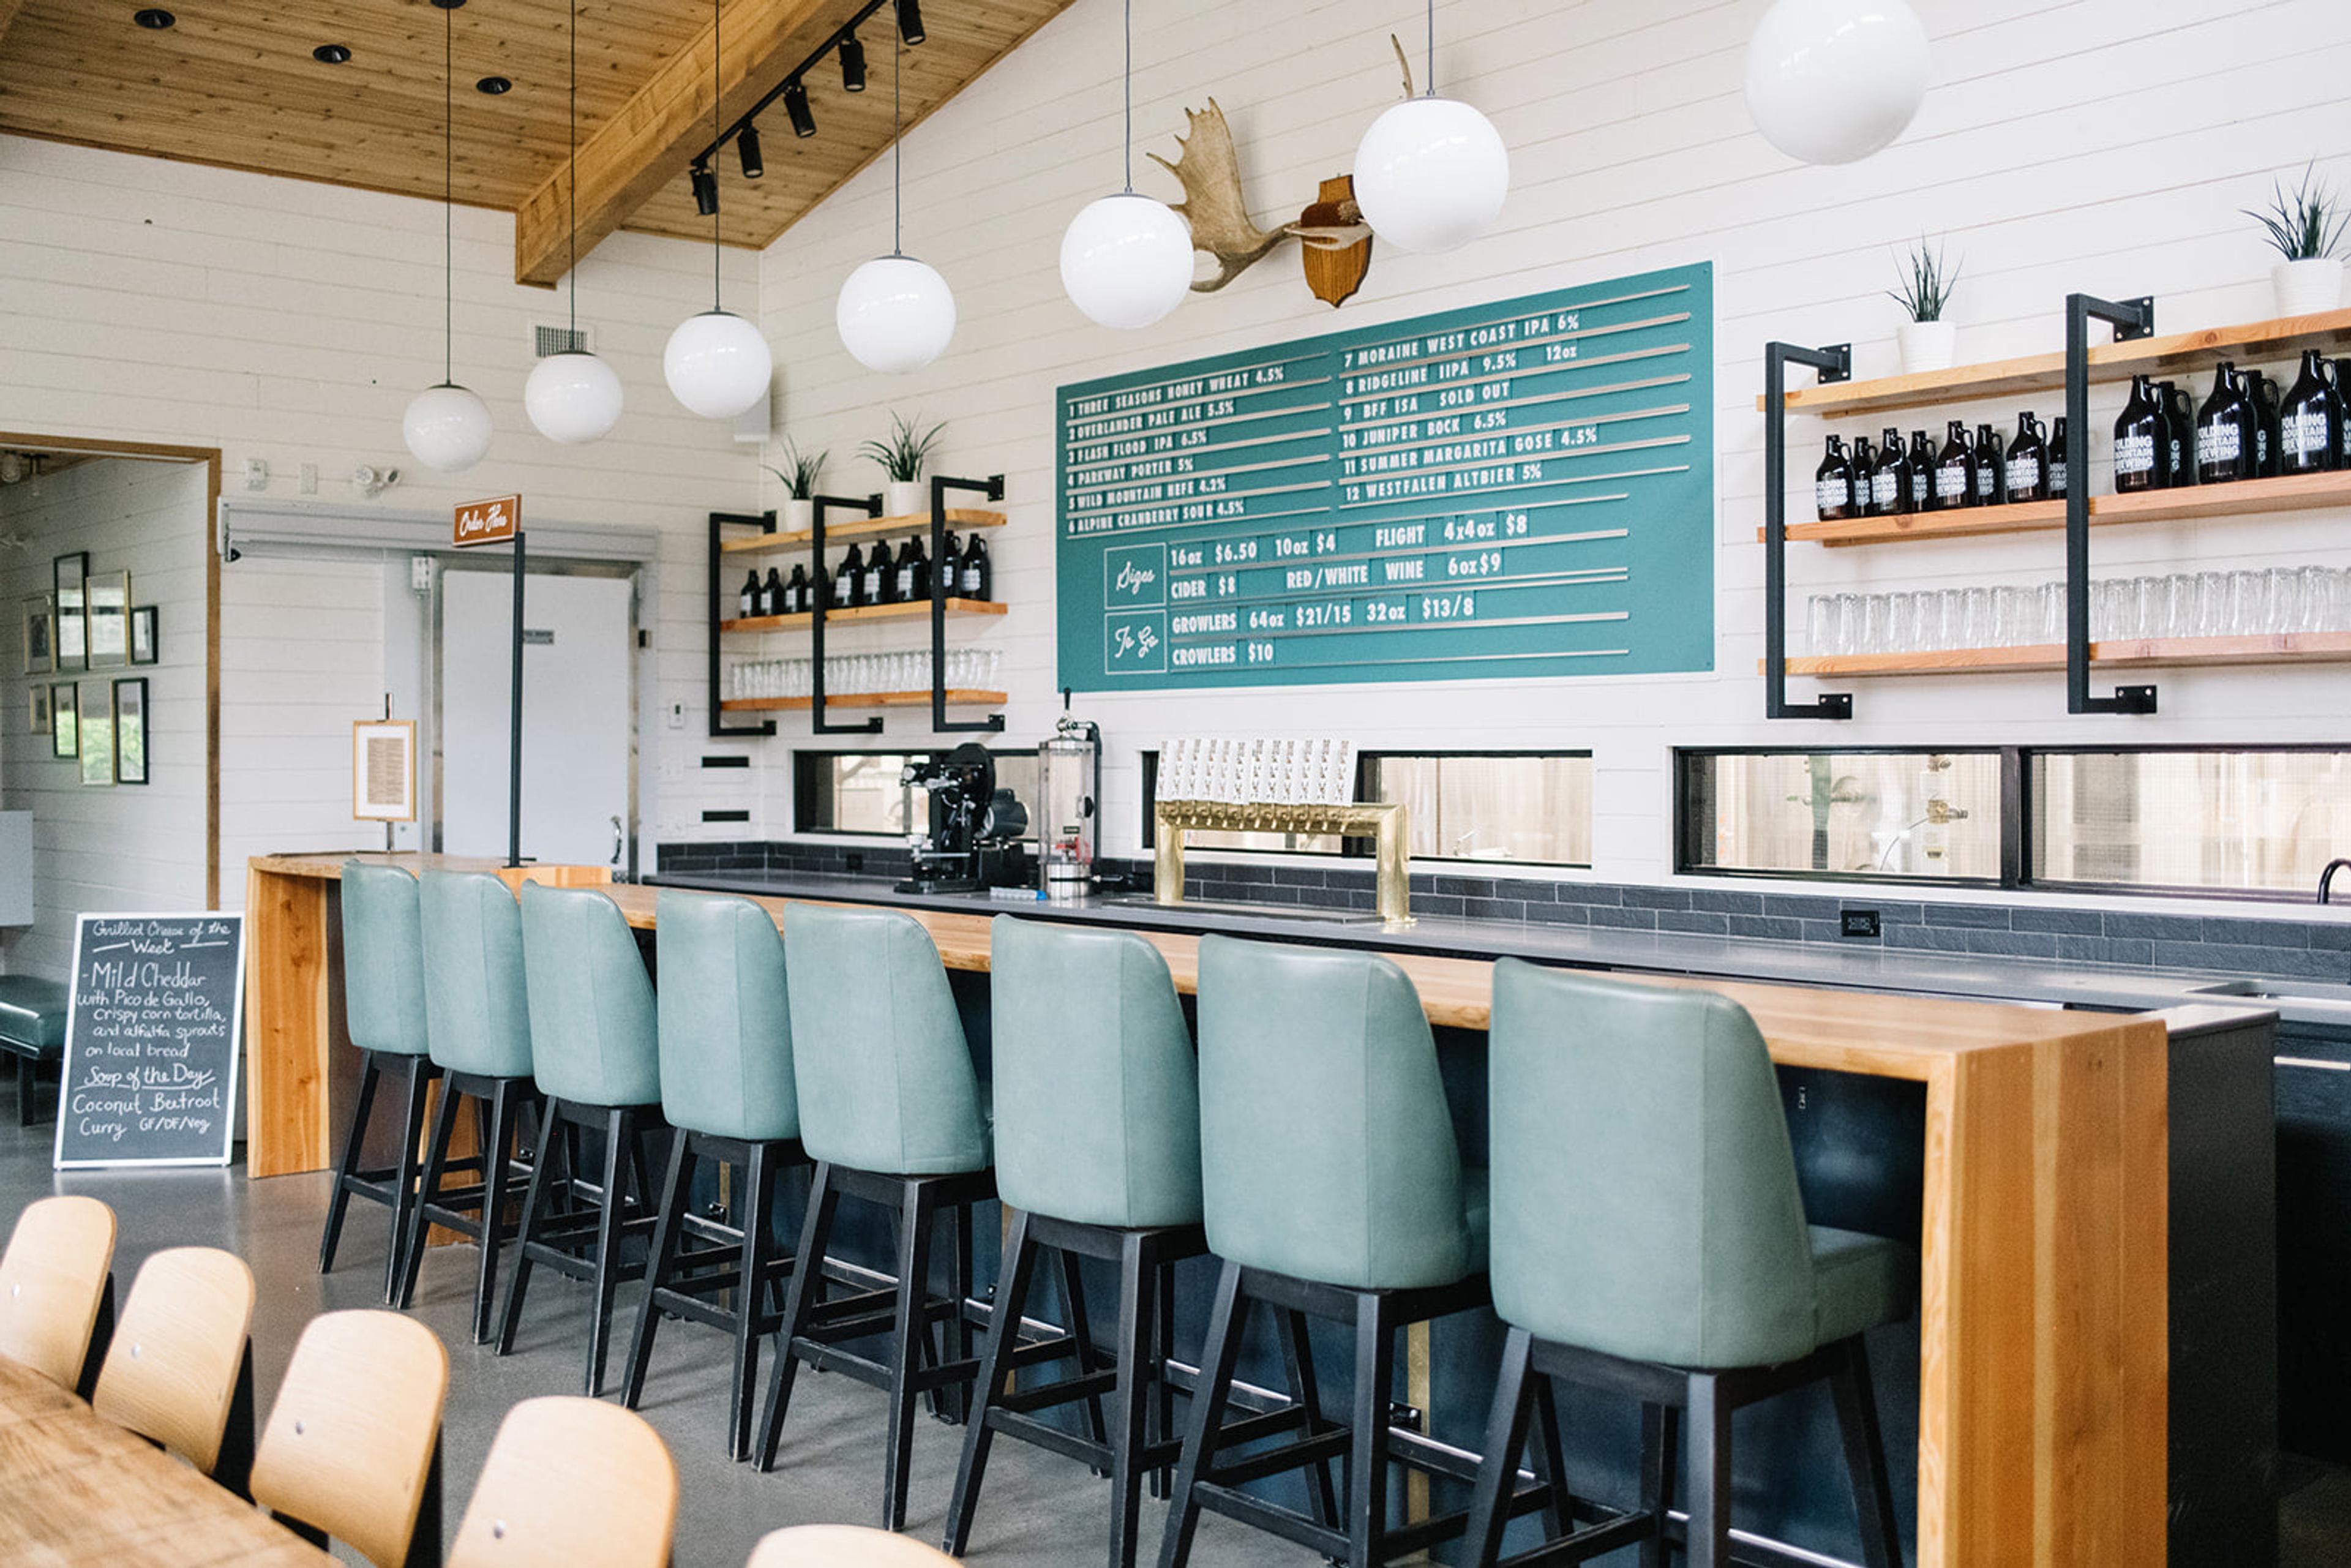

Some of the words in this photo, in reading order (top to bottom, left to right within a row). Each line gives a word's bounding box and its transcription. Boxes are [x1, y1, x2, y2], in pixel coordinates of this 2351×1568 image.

[1344, 353, 1352, 368] 7
[1357, 342, 1418, 366] MORAINE
[1427, 333, 1464, 353] WEST
[1470, 323, 1515, 346] COAST
[1524, 318, 1550, 336] IPA
[1557, 314, 1579, 330] 6%
[1346, 380, 1354, 395] 8
[1359, 367, 1427, 392] RIDGELINE
[1439, 361, 1469, 379] IIPA
[1482, 353, 1517, 372] 9.5%
[1546, 345, 1577, 361] 12oz
[1070, 405, 1074, 417] 1
[1078, 399, 1109, 416] THREE
[1116, 388, 1162, 409] SEASONS
[1167, 380, 1203, 399] HONEY
[1209, 372, 1248, 392] WHEAT
[1256, 366, 1284, 383] 4.5%
[1344, 407, 1352, 421] 9
[1363, 402, 1387, 418] BFF
[1395, 397, 1418, 414] ISA
[1439, 388, 1474, 407] SOLD
[1482, 381, 1510, 400] OUT
[1069, 427, 1074, 440] 2
[1078, 416, 1143, 438] OVERLANDER
[1148, 410, 1175, 427] PALE
[1181, 405, 1201, 422] ALE
[1207, 400, 1234, 417] 5.5%
[1343, 433, 1357, 448] 10
[1362, 424, 1417, 446] JUNIPER
[1428, 418, 1460, 436] BOCK
[1474, 411, 1506, 429] 6.5%
[1068, 450, 1074, 463] 3
[1078, 445, 1109, 462] FLASH
[1113, 440, 1147, 457] FLOOD
[1154, 435, 1173, 451] IPA
[1181, 429, 1207, 446] 6.5%
[1344, 460, 1355, 475] 11
[1360, 451, 1418, 472] SUMMER
[1423, 439, 1506, 464] MARGARITA
[1515, 433, 1552, 452] GOSE
[1561, 427, 1597, 446] 4.5%
[1078, 467, 1126, 486] PARKWAY
[1131, 460, 1172, 478] PORTER
[1177, 458, 1193, 471] 5%
[1346, 486, 1360, 501] 12
[1366, 475, 1446, 498] WESTFALEN
[1453, 467, 1515, 488] ALTBIER
[1522, 463, 1542, 480] 5%
[1069, 497, 1074, 509] 5
[1077, 493, 1103, 509] WILD
[1106, 485, 1162, 505] MOUNTAIN
[1168, 481, 1194, 497] HEFE
[1199, 477, 1226, 493] 4.2%
[1077, 516, 1113, 532] ALPINE
[1117, 508, 1179, 527] CRANBERRY
[1183, 503, 1213, 520] SOUR
[1217, 499, 1244, 516] 4.5%
[1171, 549, 1203, 566] 16oz
[1215, 541, 1258, 564] $6.50
[1275, 538, 1309, 557] 10oz
[1316, 533, 1335, 553] $4
[1376, 525, 1425, 547] FLIGHT
[1444, 519, 1496, 541] 4x4oz
[1506, 512, 1528, 536] $8
[1116, 560, 1156, 595] Sizes
[1171, 580, 1206, 599] CIDER
[1218, 576, 1235, 596] $8
[1385, 560, 1423, 580] WINE
[1448, 557, 1477, 576] 6oz
[1479, 552, 1501, 576] $9
[1172, 613, 1237, 634] GROWLERS
[1250, 611, 1284, 628] 64oz
[1296, 602, 1351, 627] $21/15
[1367, 602, 1406, 621] 32oz
[1423, 594, 1474, 620] $13/8
[1114, 626, 1135, 658] To
[1138, 626, 1159, 658] Go
[1172, 646, 1236, 666] CROWLERS
[1248, 642, 1273, 662] $10
[130, 938, 175, 955] Week
[189, 921, 204, 943] of
[208, 921, 231, 935] the
[141, 961, 207, 988] Cheddar
[77, 990, 110, 1007] with
[114, 989, 142, 1007] Pico
[143, 991, 160, 1007] de
[141, 1010, 171, 1020] corn
[84, 1046, 103, 1057] on
[107, 1041, 140, 1057] local
[147, 1042, 192, 1058] bread
[92, 1024, 120, 1037] and
[175, 1023, 227, 1045] sprouts
[83, 1065, 122, 1089] Soup
[126, 1066, 141, 1092] of
[143, 1066, 171, 1084] the
[173, 1062, 213, 1090] Day
[72, 1092, 143, 1116] Coconut
[80, 1117, 128, 1142] Curry
